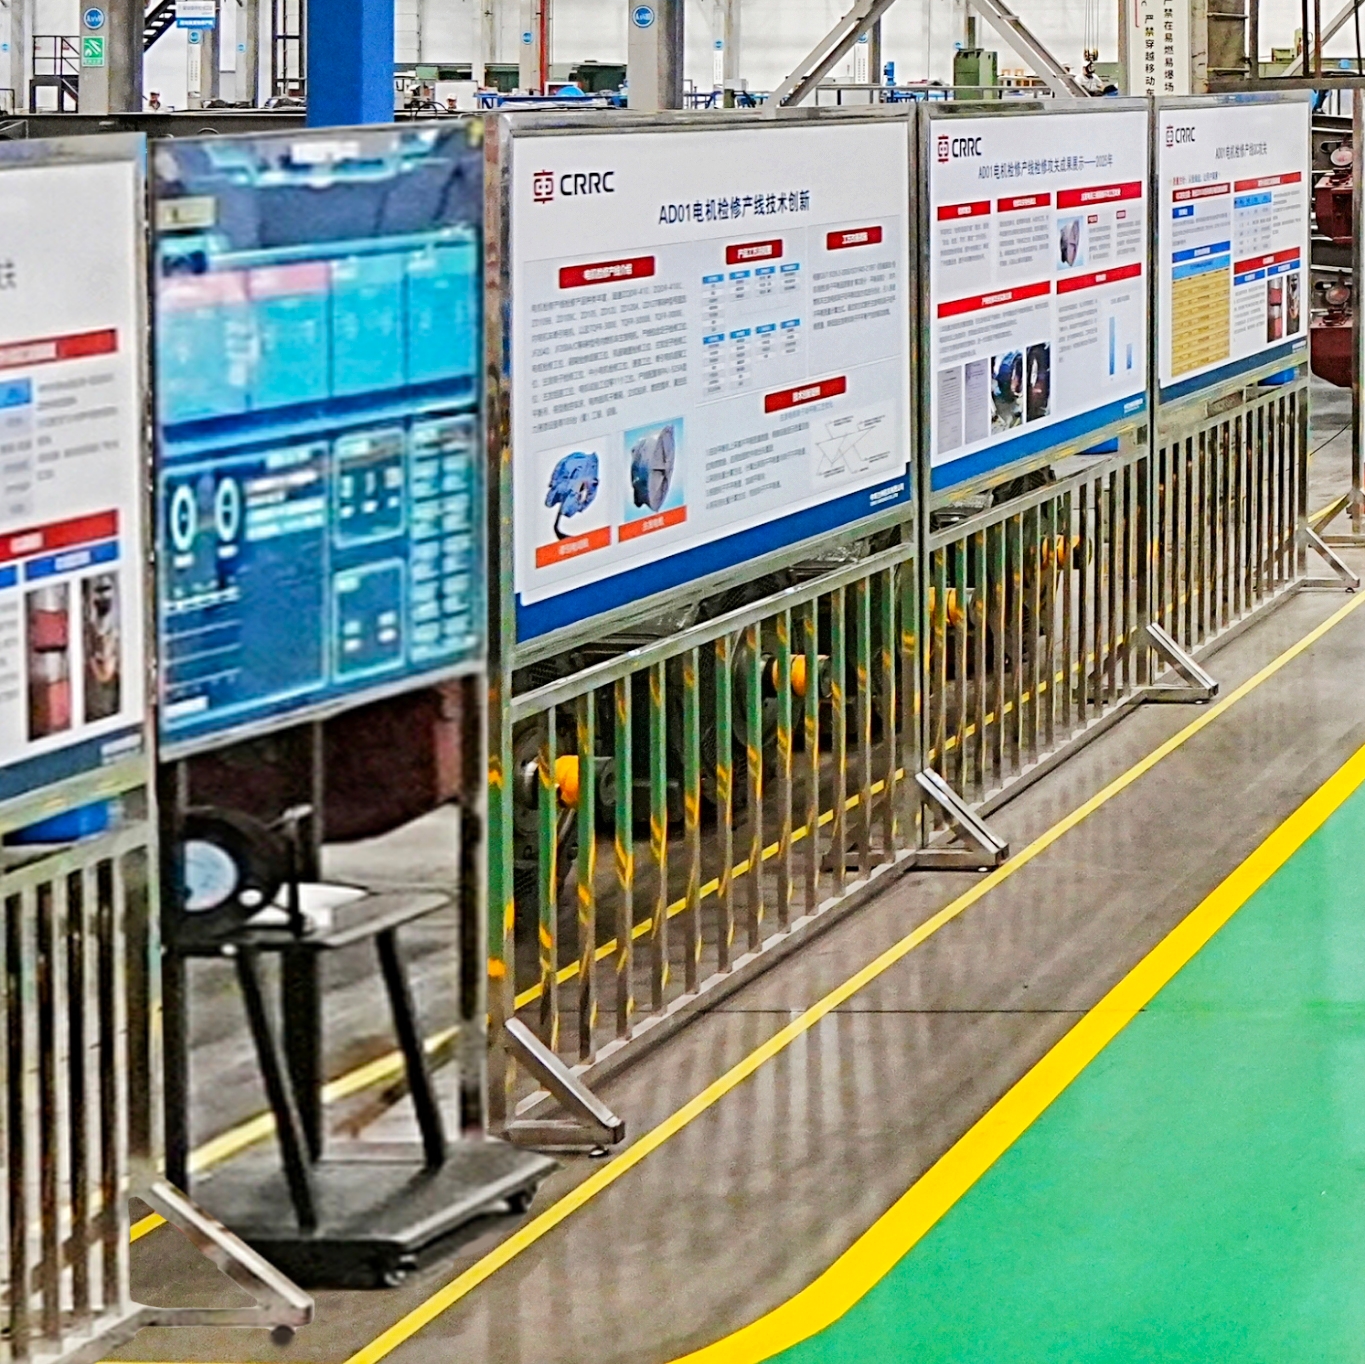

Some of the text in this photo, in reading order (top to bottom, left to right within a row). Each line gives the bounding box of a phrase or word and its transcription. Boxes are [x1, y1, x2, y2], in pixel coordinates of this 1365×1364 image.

[1175, 127, 1195, 144] CRRC
[952, 137, 982, 158] CRRC
[560, 171, 615, 196] CRRC
[659, 189, 810, 225] AD01电机检修产线技术创新
